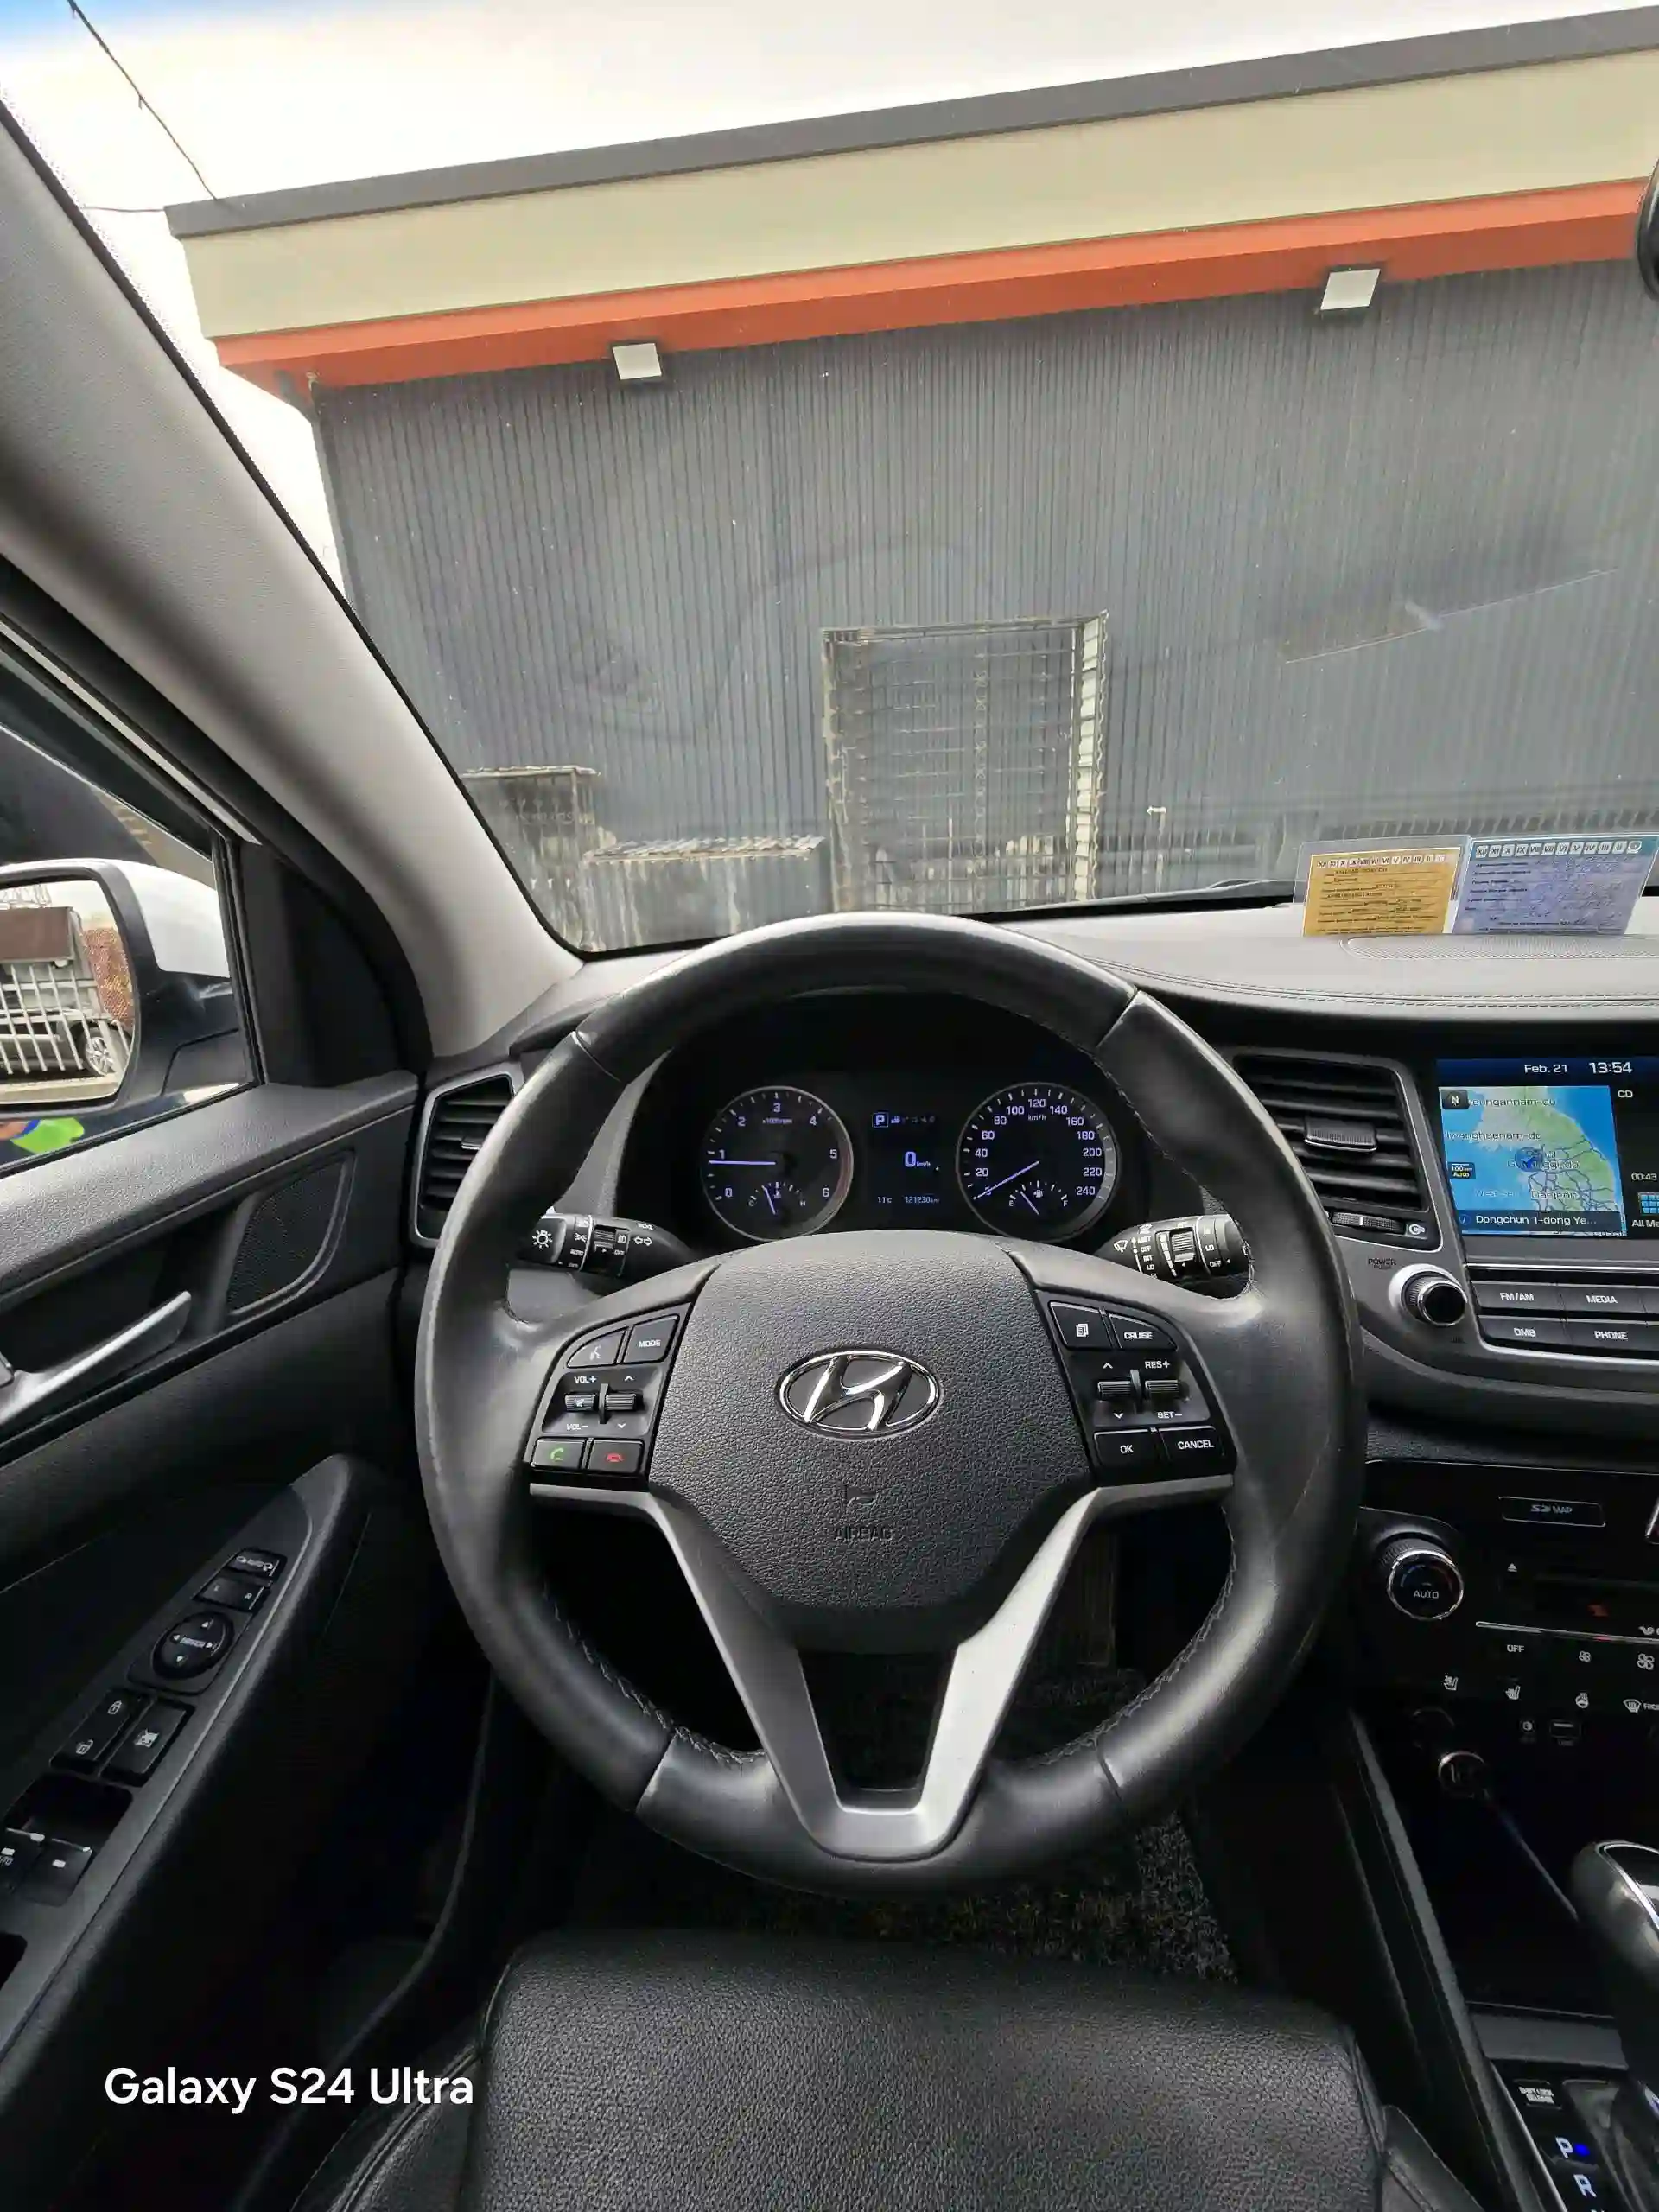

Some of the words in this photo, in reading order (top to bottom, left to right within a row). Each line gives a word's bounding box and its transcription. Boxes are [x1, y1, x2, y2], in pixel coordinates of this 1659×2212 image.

[1524, 1064, 1550, 1073] Feb.
[1554, 1064, 1568, 1073] 21
[1589, 1061, 1633, 1074] 13:54
[1618, 1090, 1633, 1098] CD
[772, 1103, 781, 1113] 3
[1028, 1098, 1046, 1108] 120
[1006, 1105, 1025, 1115] 100
[1049, 1105, 1068, 1115] 140
[737, 1116, 746, 1127] 2
[809, 1116, 817, 1126] 4
[994, 1116, 1007, 1125] 80
[1065, 1116, 1084, 1126] 160
[981, 1130, 995, 1140] 60
[1076, 1130, 1096, 1140] 180
[719, 1149, 725, 1160] 1
[830, 1148, 837, 1159] 5
[975, 1147, 988, 1158] 40
[1083, 1147, 1103, 1157] 200
[904, 1151, 917, 1168] 0
[976, 1167, 989, 1177] 20
[1083, 1167, 1103, 1177] 220
[725, 1187, 733, 1198] 0
[822, 1187, 830, 1198] 6
[1076, 1186, 1096, 1196] 240
[1476, 1215, 1529, 1225] Dongchun
[1534, 1216, 1571, 1225] 1-dong
[1368, 1257, 1397, 1266] POWER
[1500, 1292, 1535, 1302] FM/AM
[1586, 1295, 1618, 1304] MEDIA
[1123, 1332, 1154, 1340] CRUISE
[1513, 1327, 1537, 1338] DMB
[1594, 1330, 1629, 1340] PHONE
[638, 1339, 661, 1348] MODE
[1120, 1445, 1134, 1453] OK
[1177, 1440, 1215, 1450] CANCEL
[1413, 1589, 1440, 1599] AUTO
[1555, 2137, 1573, 2158] P
[1573, 2174, 1597, 2197] R
